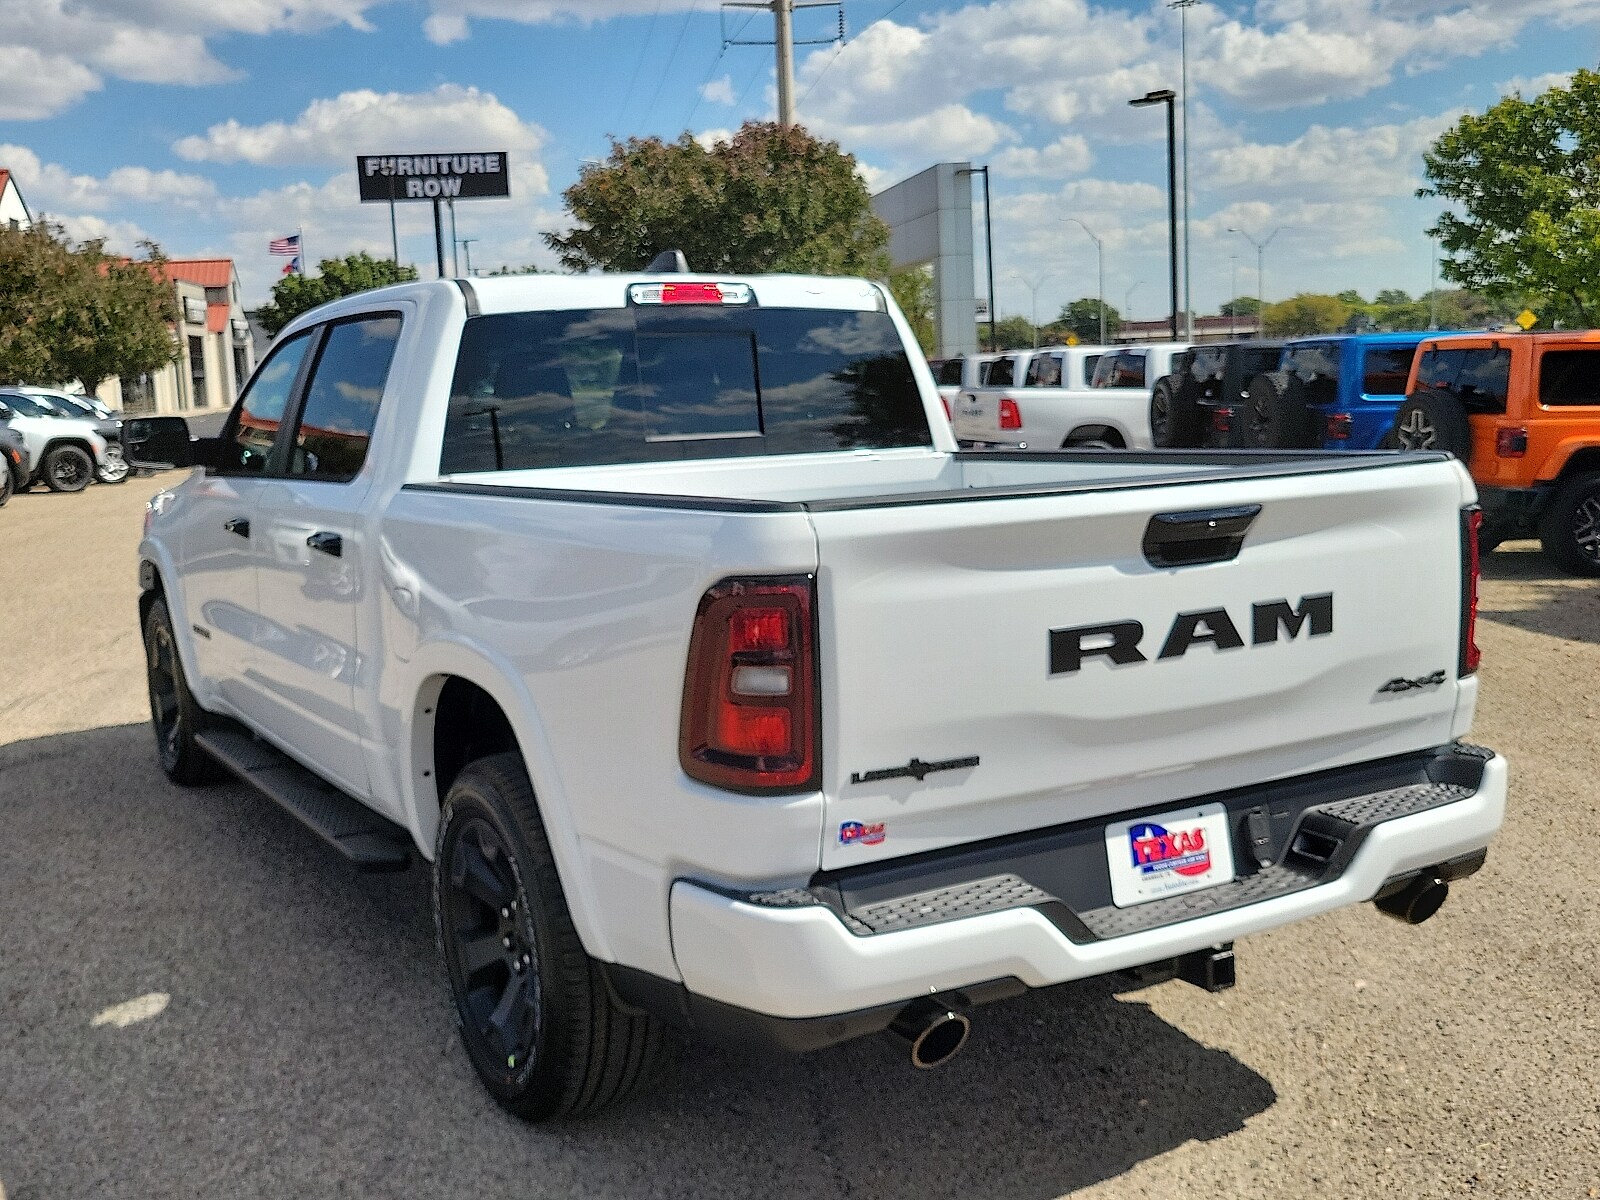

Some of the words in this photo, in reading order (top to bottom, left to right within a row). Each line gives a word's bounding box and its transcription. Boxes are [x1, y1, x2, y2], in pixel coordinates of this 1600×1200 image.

[364, 153, 501, 177] FURNITURE
[405, 176, 462, 198] ROW
[1047, 591, 1334, 675] RAM
[1133, 827, 1206, 865] TEXAS
